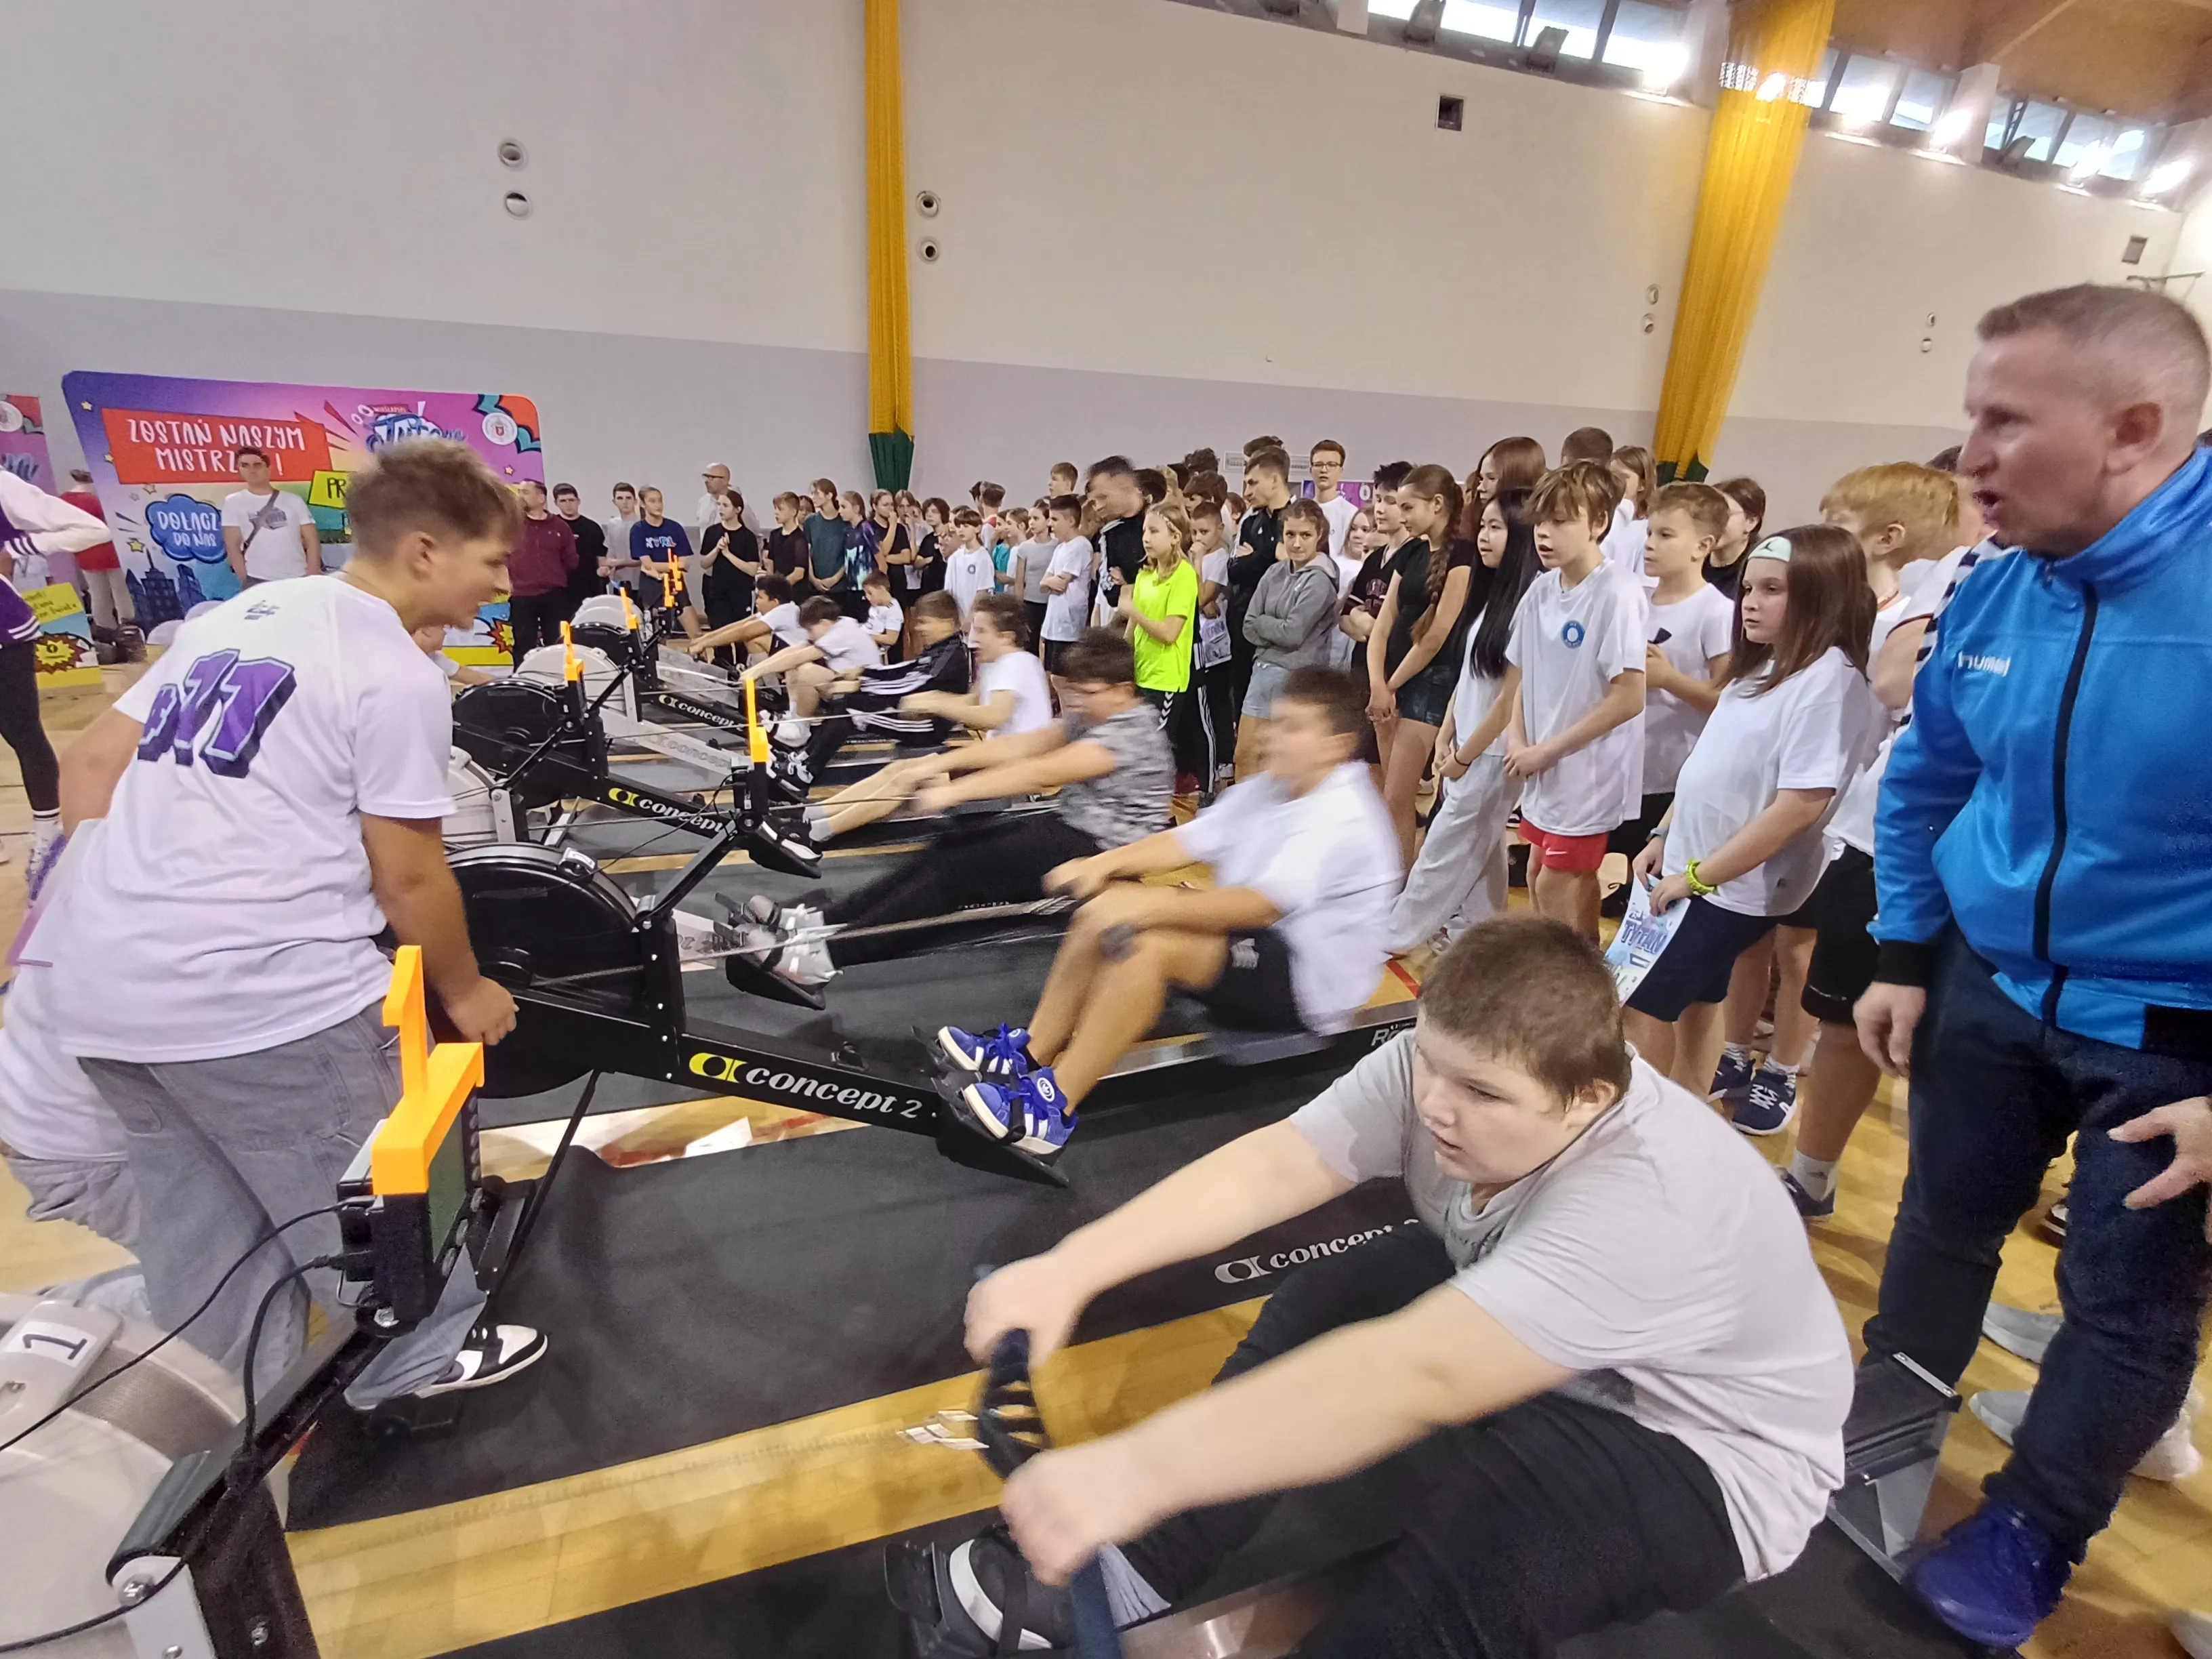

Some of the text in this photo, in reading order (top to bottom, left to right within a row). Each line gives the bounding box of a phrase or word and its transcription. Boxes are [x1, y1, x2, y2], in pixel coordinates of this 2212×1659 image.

[127, 418, 306, 451] ZOSTAŃ NASZYM
[173, 531, 217, 548] DO NAS
[678, 702, 735, 728] concept
[667, 739, 731, 770] concep
[638, 798, 724, 833] concept
[745, 1065, 923, 1119] concept 2
[1269, 1211, 1393, 1268] conce
[22, 1334, 87, 1360] 1
